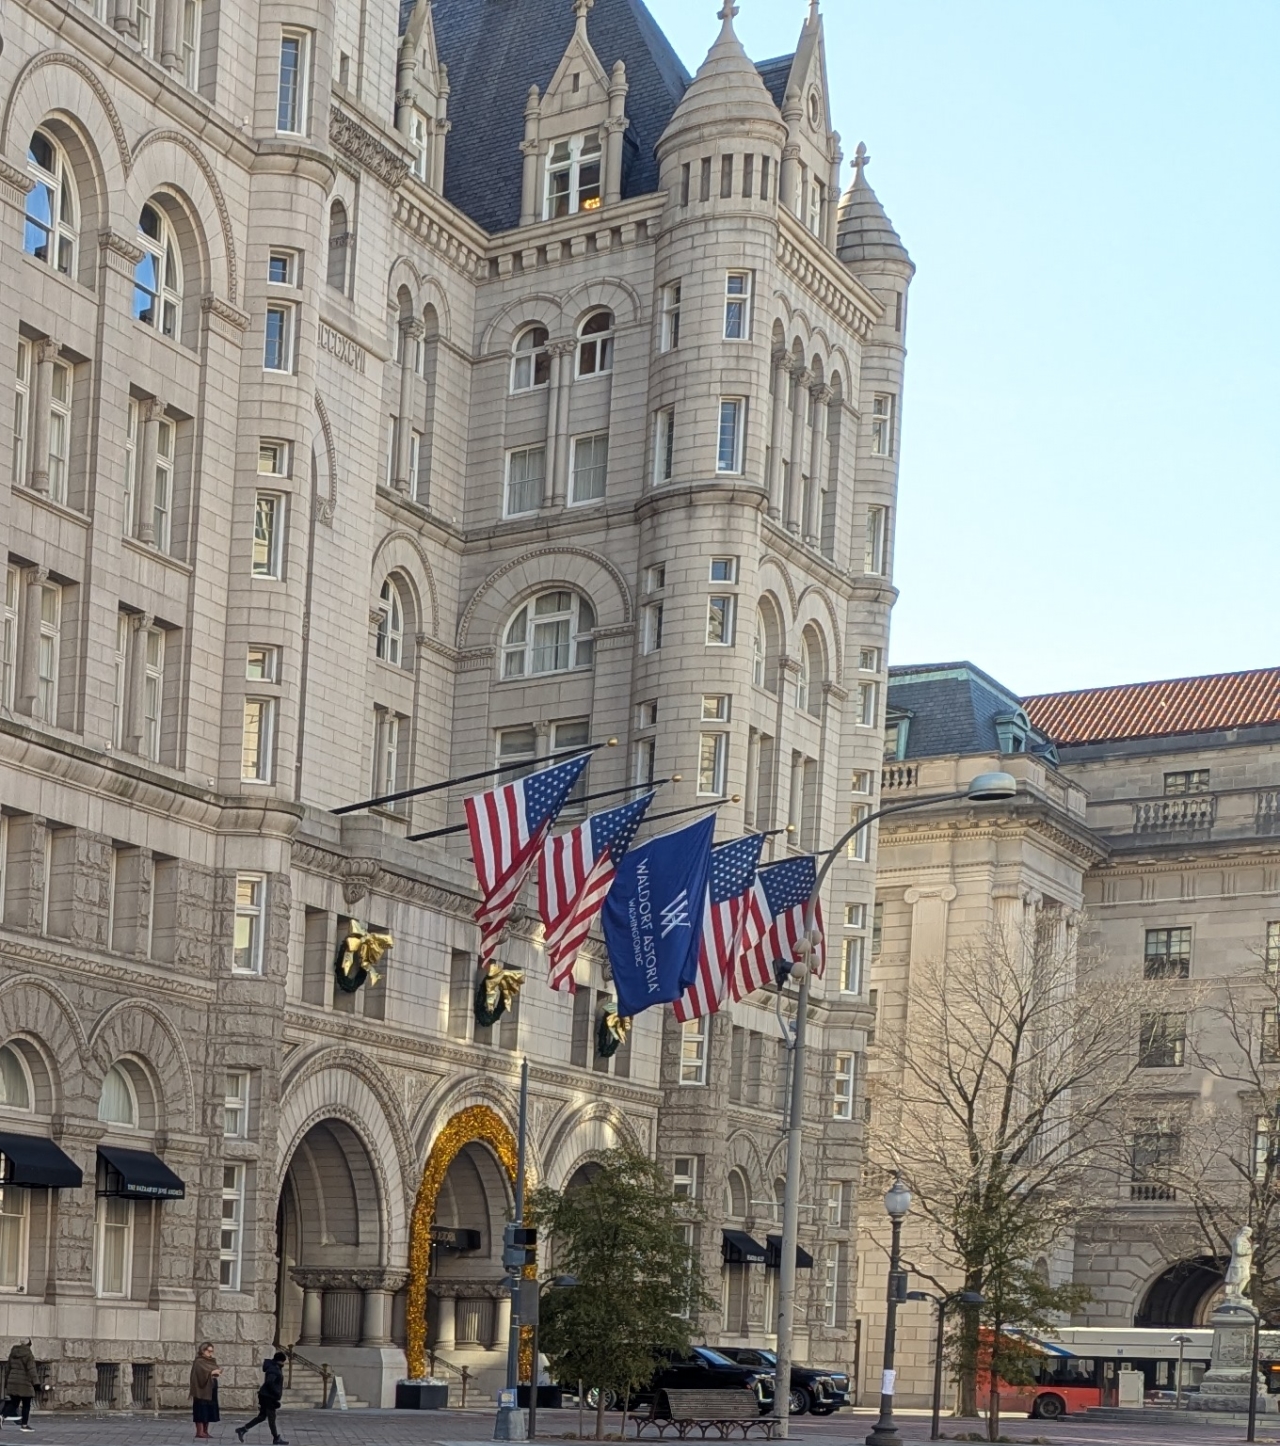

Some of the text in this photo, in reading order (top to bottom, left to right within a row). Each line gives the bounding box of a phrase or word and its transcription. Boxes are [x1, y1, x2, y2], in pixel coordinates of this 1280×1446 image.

[628, 898, 641, 954] WASHINGTON
[636, 857, 659, 994] WALDORF ASTORIA
